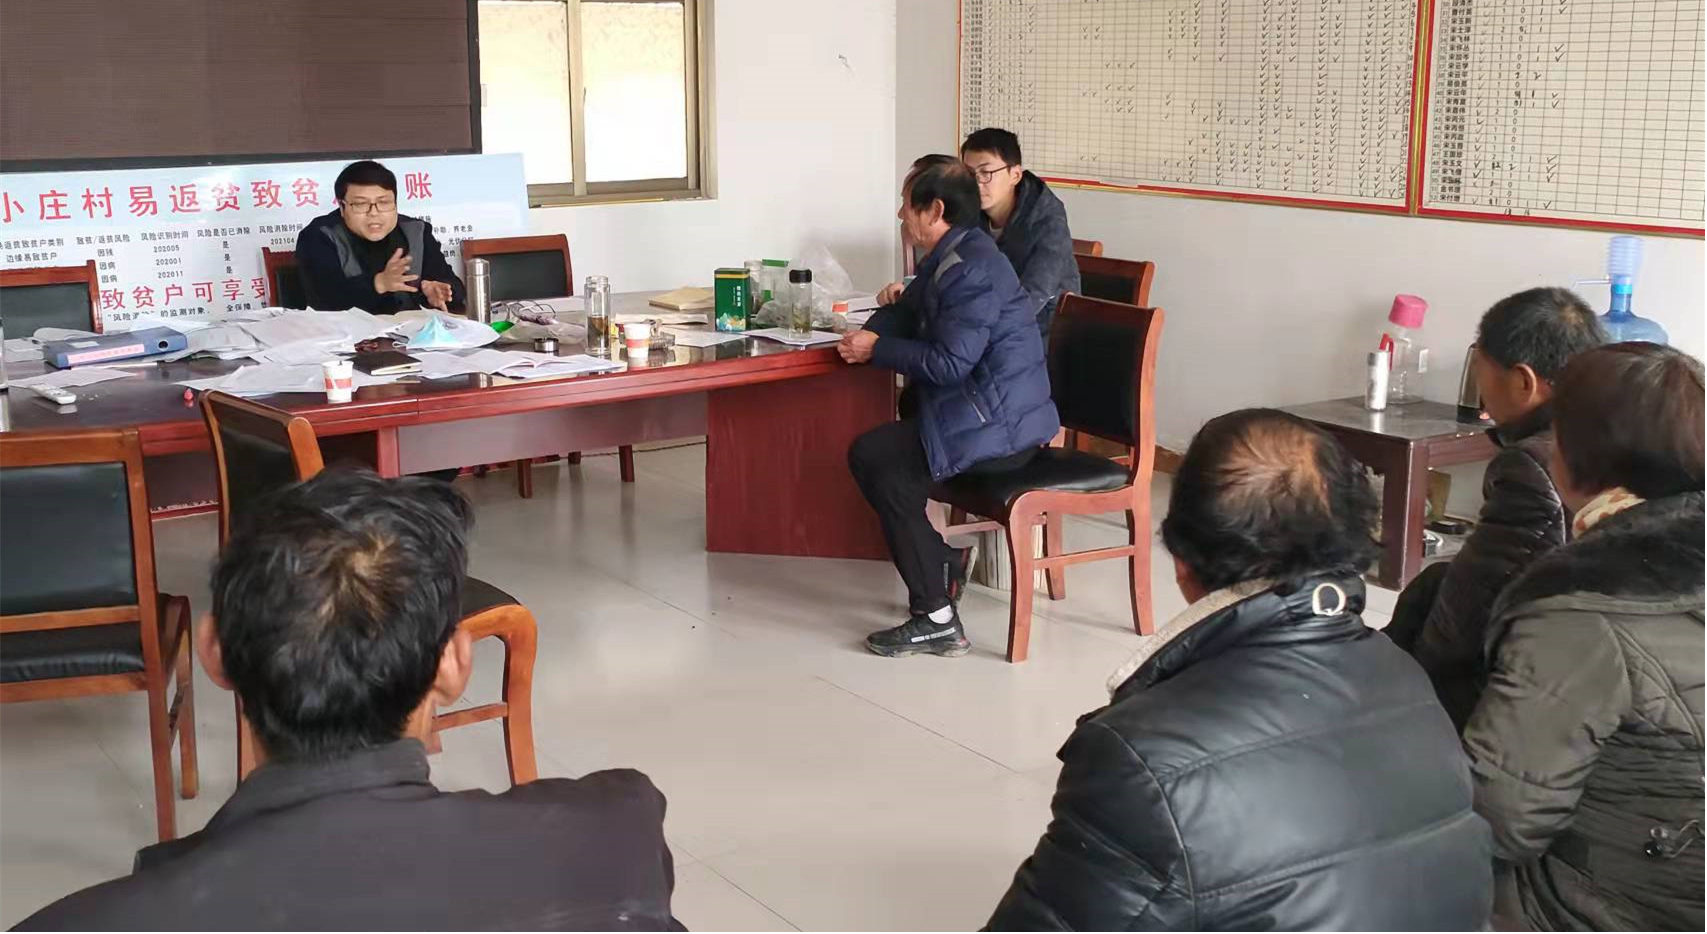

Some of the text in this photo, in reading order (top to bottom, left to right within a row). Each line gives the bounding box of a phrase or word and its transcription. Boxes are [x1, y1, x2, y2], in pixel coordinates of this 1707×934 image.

[153, 244, 180, 253] 202005
[222, 240, 229, 249] 是
[155, 258, 182, 266] 202001
[224, 253, 231, 262] 是
[157, 270, 184, 279] 202011
[226, 266, 233, 274] 是
